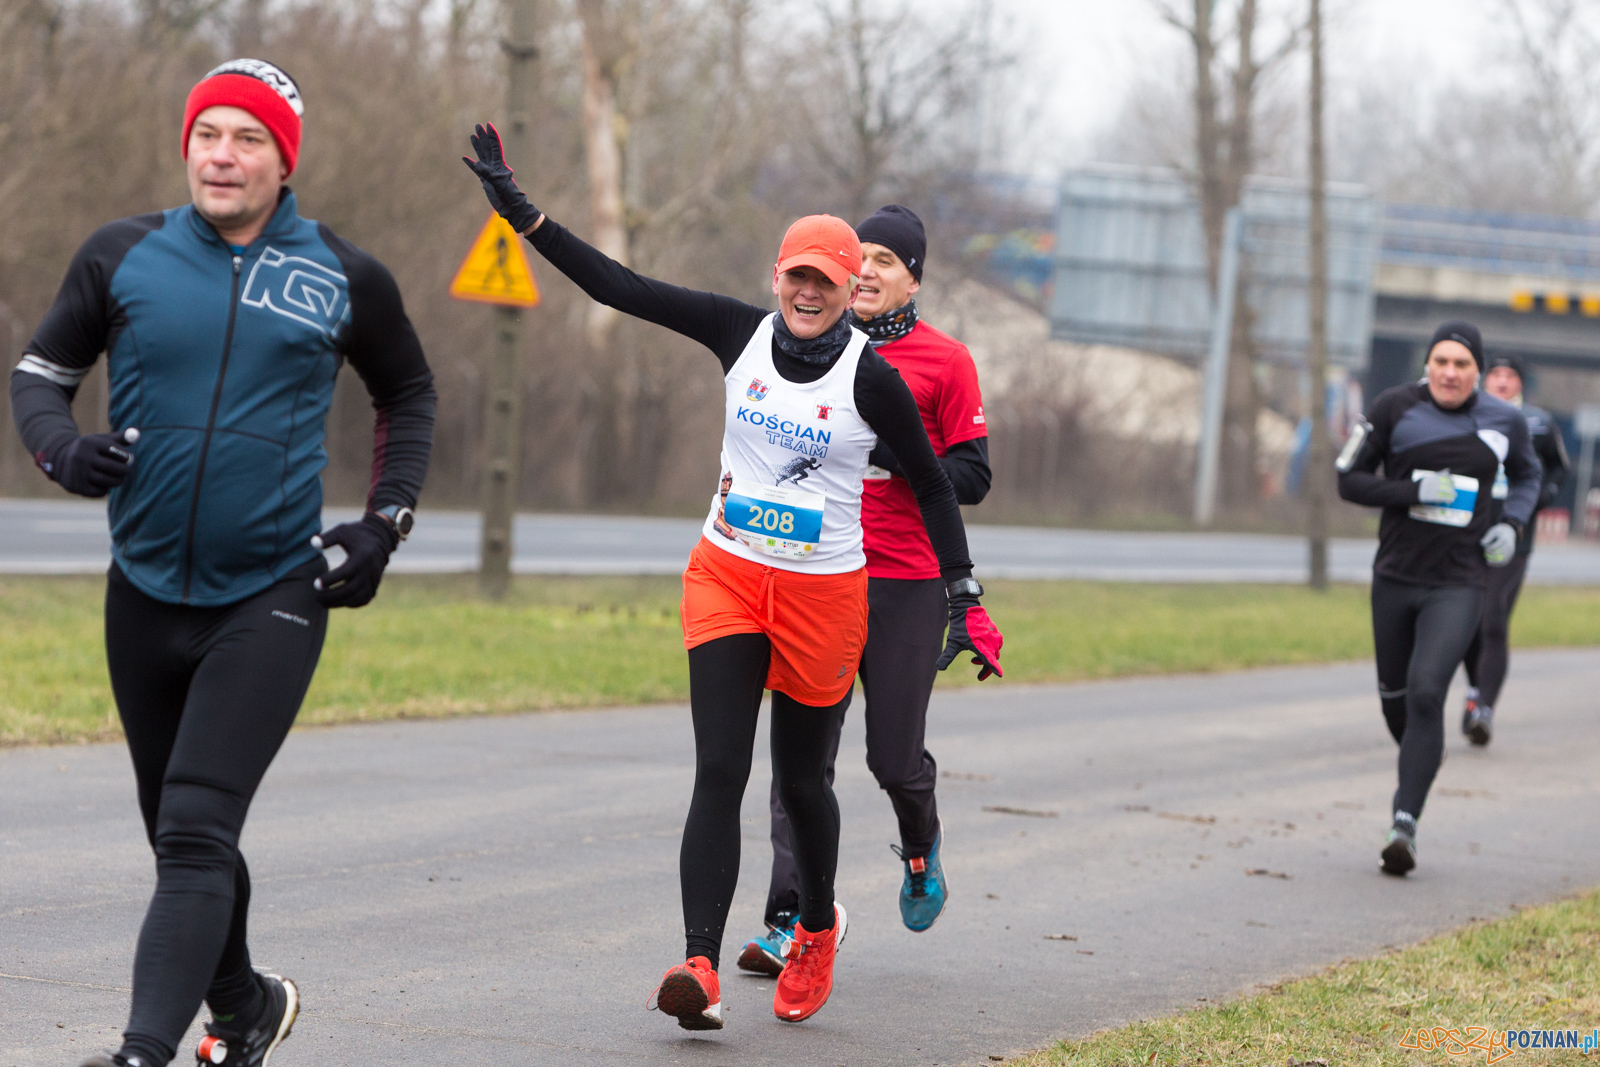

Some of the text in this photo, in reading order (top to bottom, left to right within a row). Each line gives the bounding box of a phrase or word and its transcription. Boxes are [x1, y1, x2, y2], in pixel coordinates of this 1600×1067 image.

[736, 405, 832, 444] KOŚCIAN
[765, 430, 829, 459] TEAM
[746, 505, 795, 534] 208
[271, 609, 310, 626] martes
